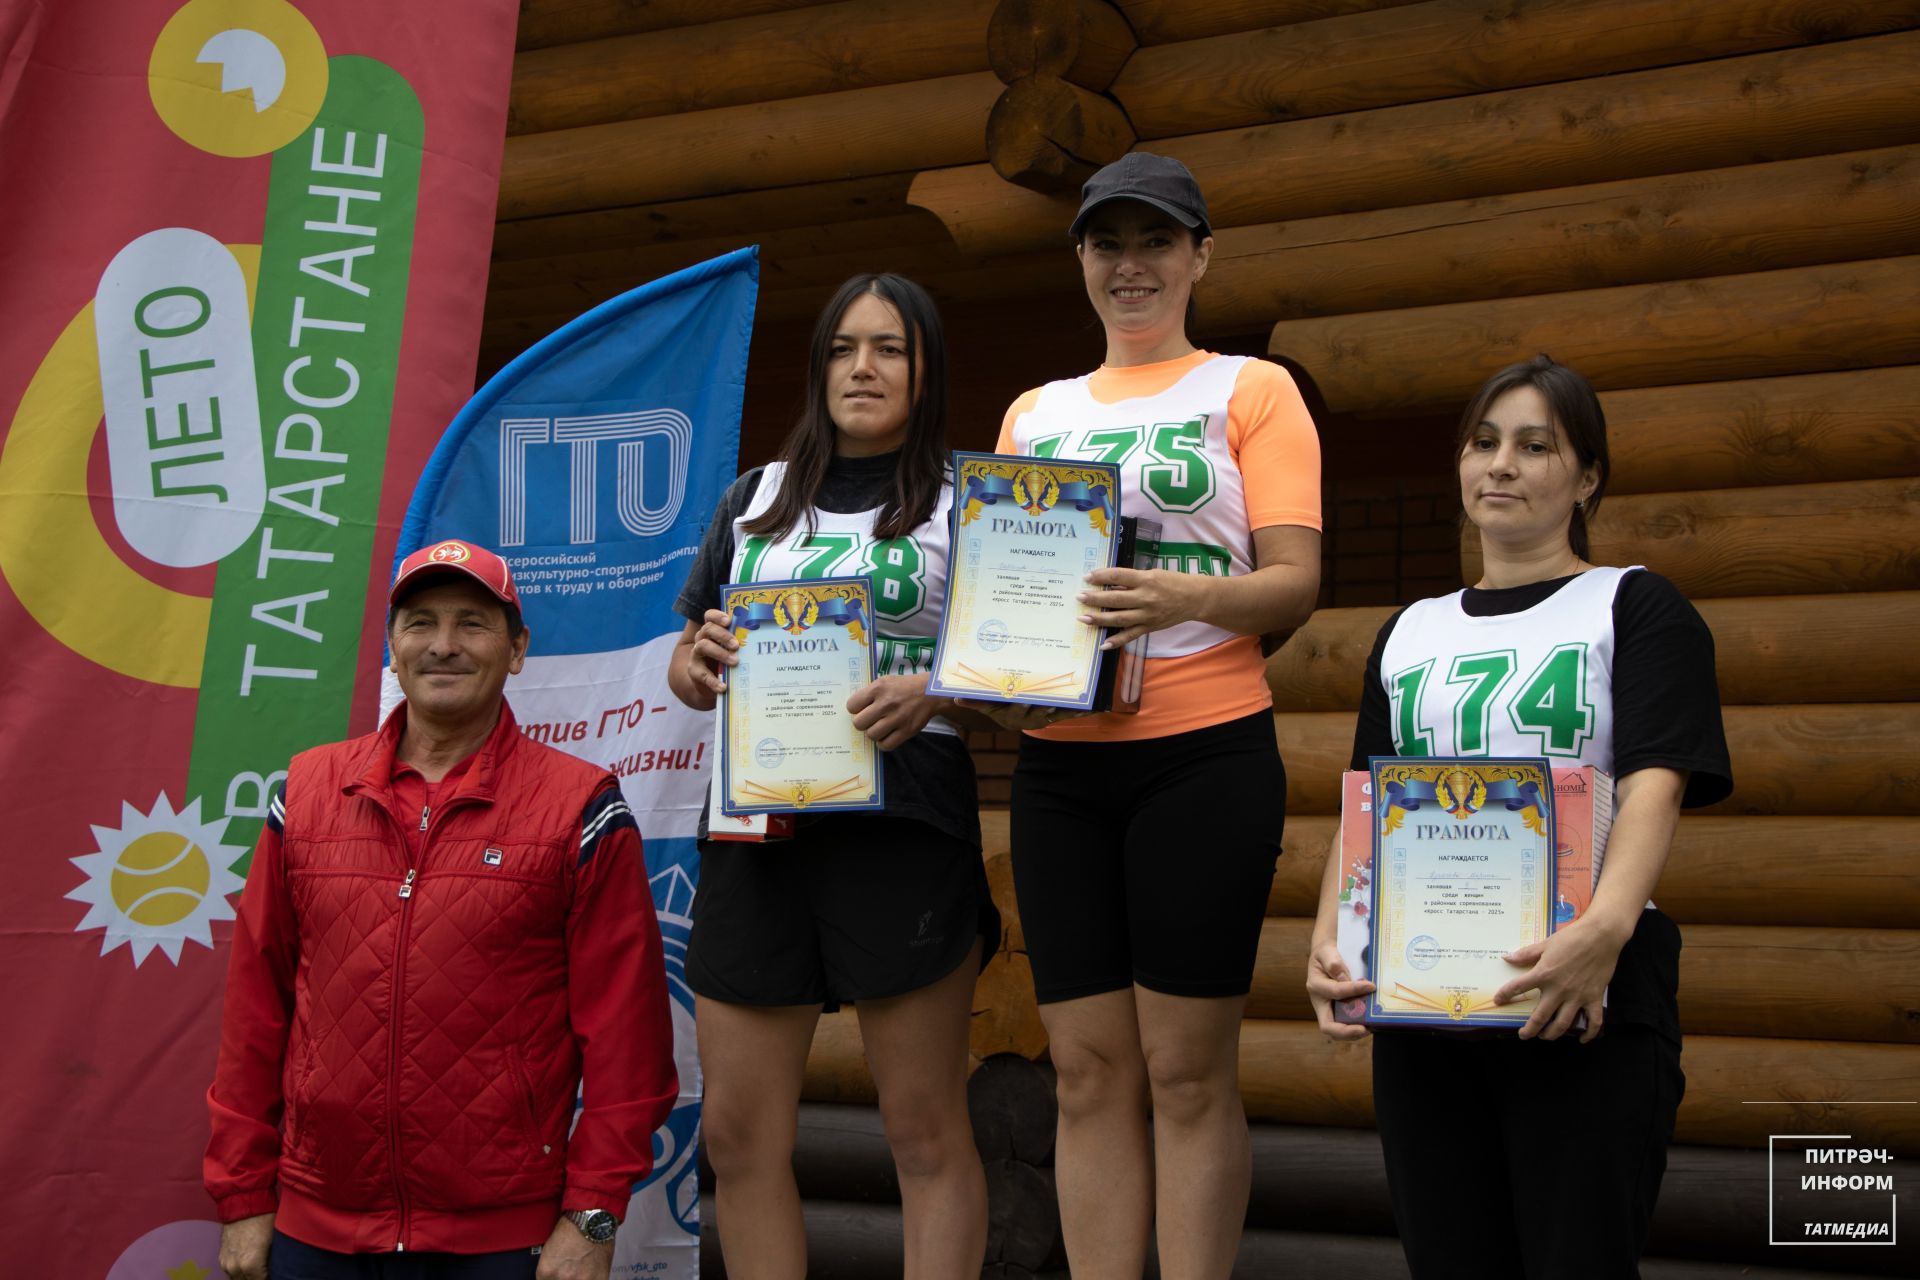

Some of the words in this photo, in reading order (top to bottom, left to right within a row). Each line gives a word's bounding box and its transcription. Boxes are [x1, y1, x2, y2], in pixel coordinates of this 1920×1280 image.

[133, 286, 229, 504] ЛЕТО
[240, 126, 388, 697] ТАТАРСТАНЕ
[499, 408, 693, 548] ГТО
[1028, 413, 1216, 514] 75
[991, 517, 1077, 538] ГРАМОТА
[1010, 548, 1056, 557] НАГРАЖДАЕТСЯ
[545, 584, 553, 593] к
[556, 581, 593, 596] труду
[597, 582, 605, 590] и
[757, 638, 840, 655] ГРАМОТА
[516, 720, 588, 744] тив
[597, 698, 644, 738] ГТО
[1391, 641, 1596, 759] 174
[609, 742, 705, 778] жизни!
[224, 770, 288, 818] В
[1415, 824, 1512, 841] ГРАМОТА
